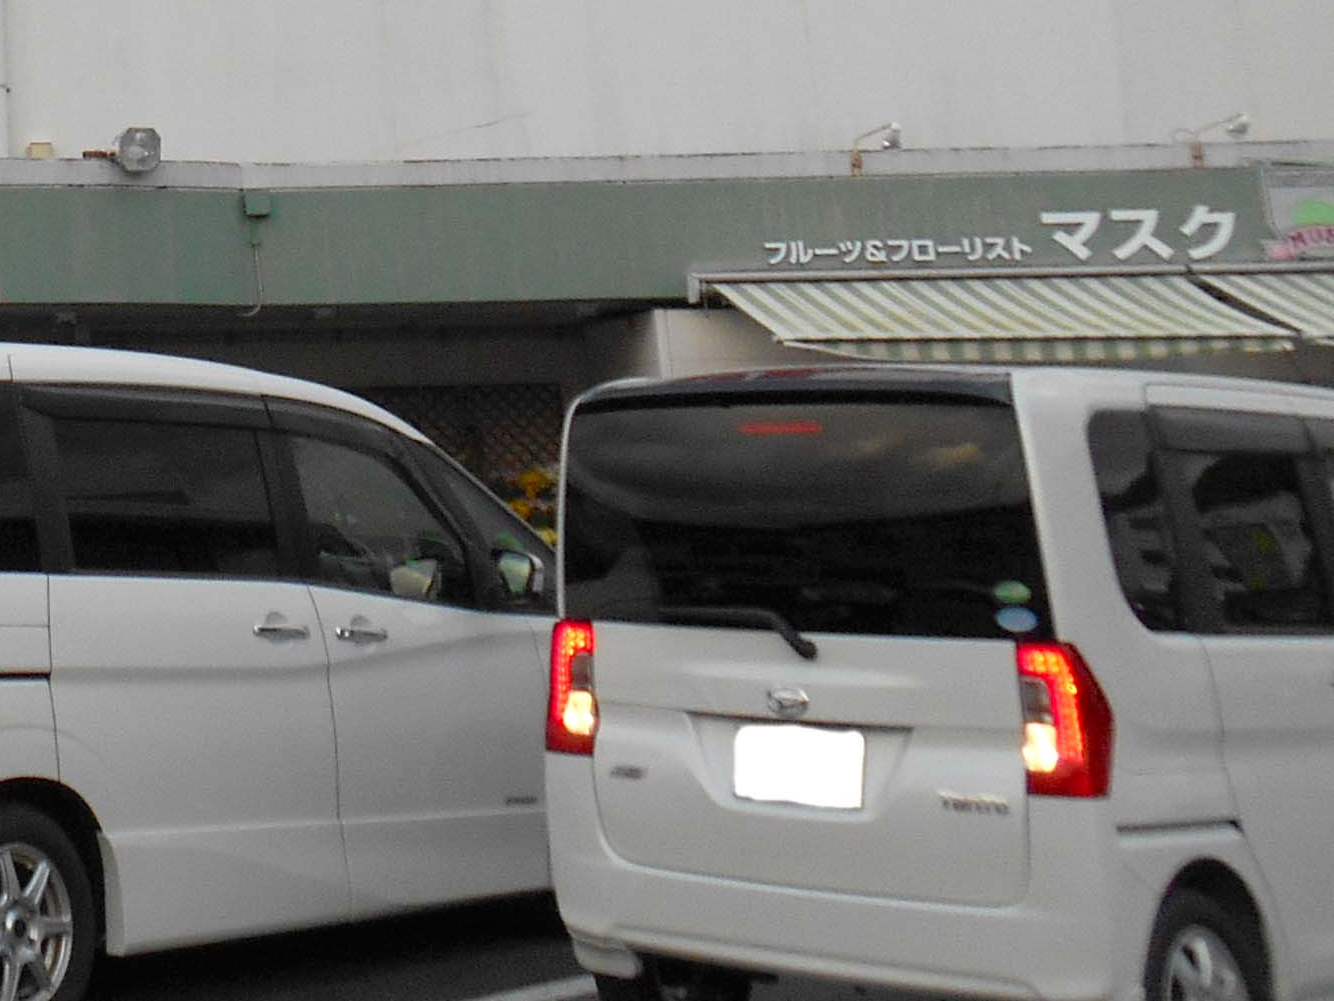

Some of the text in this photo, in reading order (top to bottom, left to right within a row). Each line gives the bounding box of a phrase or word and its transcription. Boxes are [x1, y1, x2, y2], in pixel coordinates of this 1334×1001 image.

[764, 205, 1237, 266] フルーツ&フローリスト マスク
